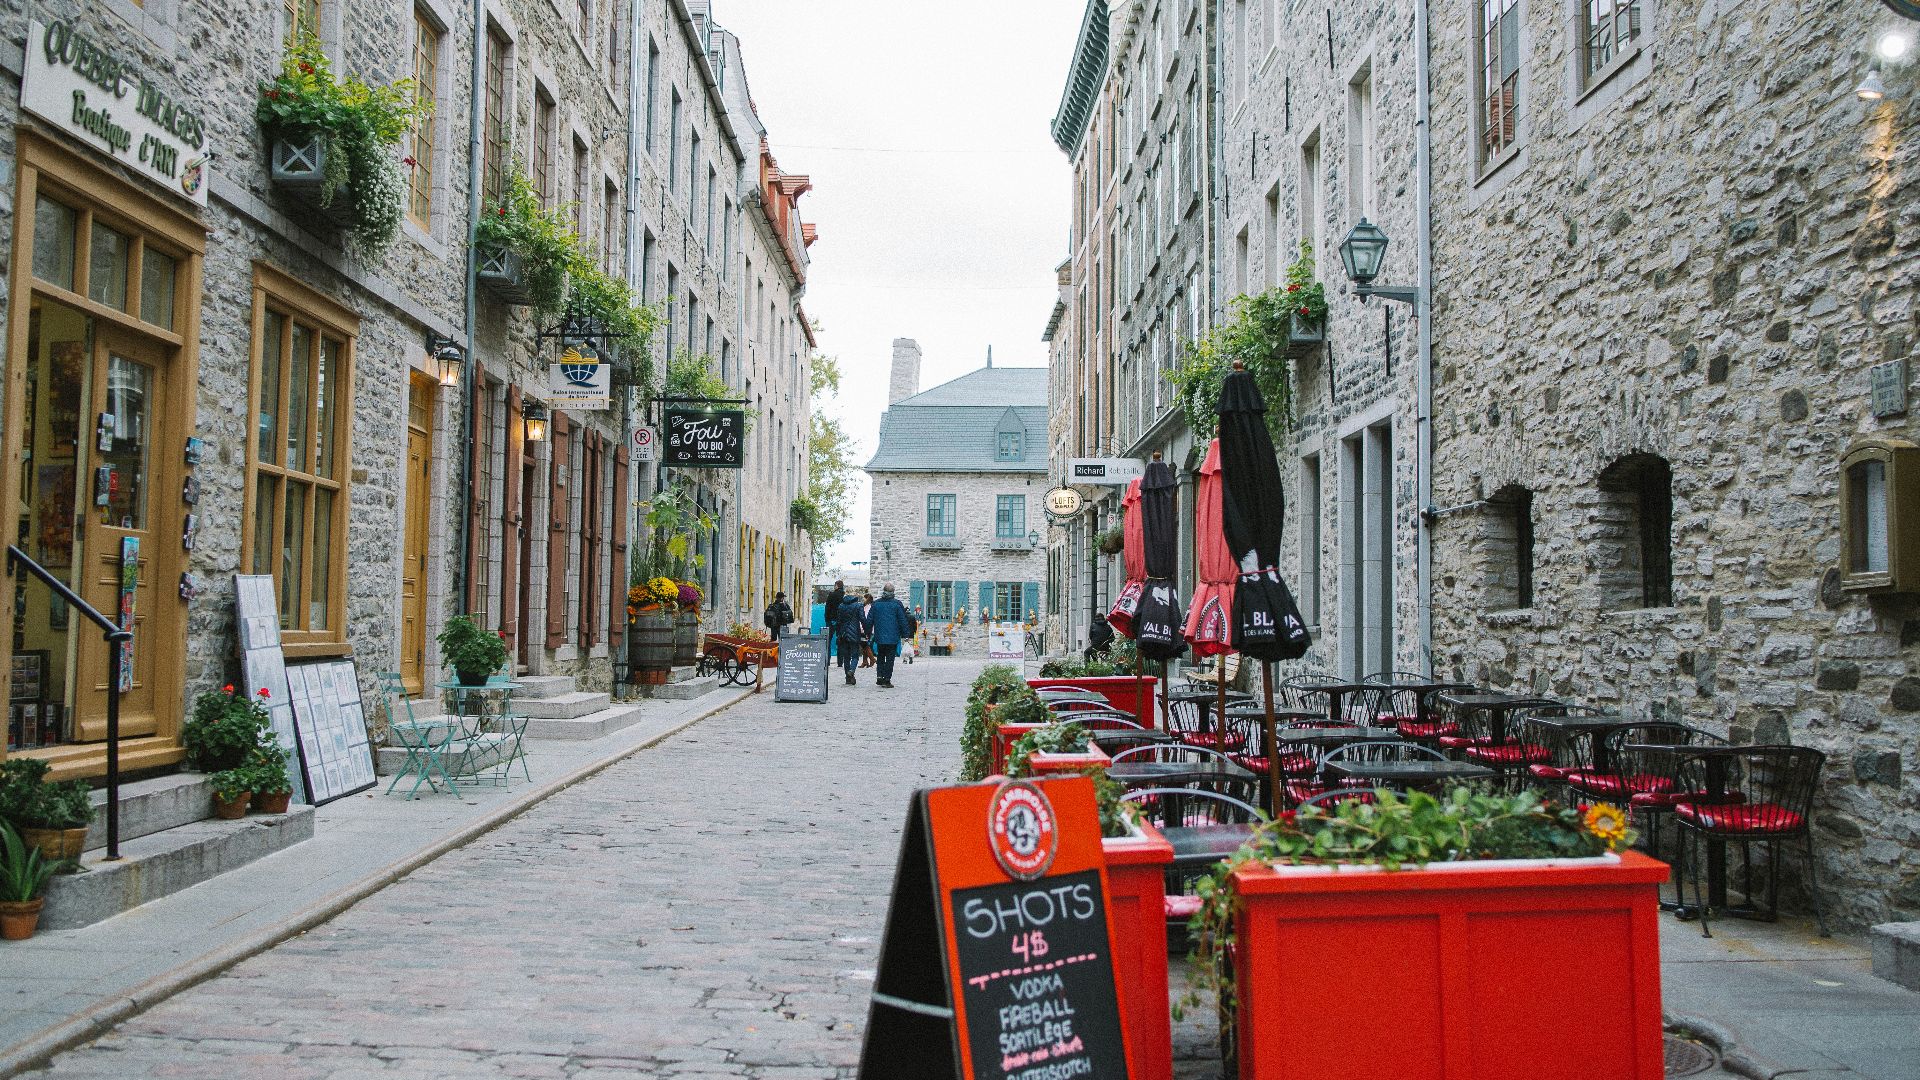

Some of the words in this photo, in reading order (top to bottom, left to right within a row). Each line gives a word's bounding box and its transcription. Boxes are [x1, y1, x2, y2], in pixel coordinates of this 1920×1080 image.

[72, 89, 131, 154] Boutique
[683, 418, 723, 445] Fou
[697, 441, 709, 451] DU
[710, 441, 724, 451] BIO
[1076, 466, 1104, 475] Richard
[1054, 496, 1075, 505] LOFTS
[963, 883, 1095, 939] SHOTS
[1011, 930, 1049, 963] 4$
[1009, 972, 1064, 1000] VODKA
[1006, 1056, 1092, 1080] TTERSCOTCH
